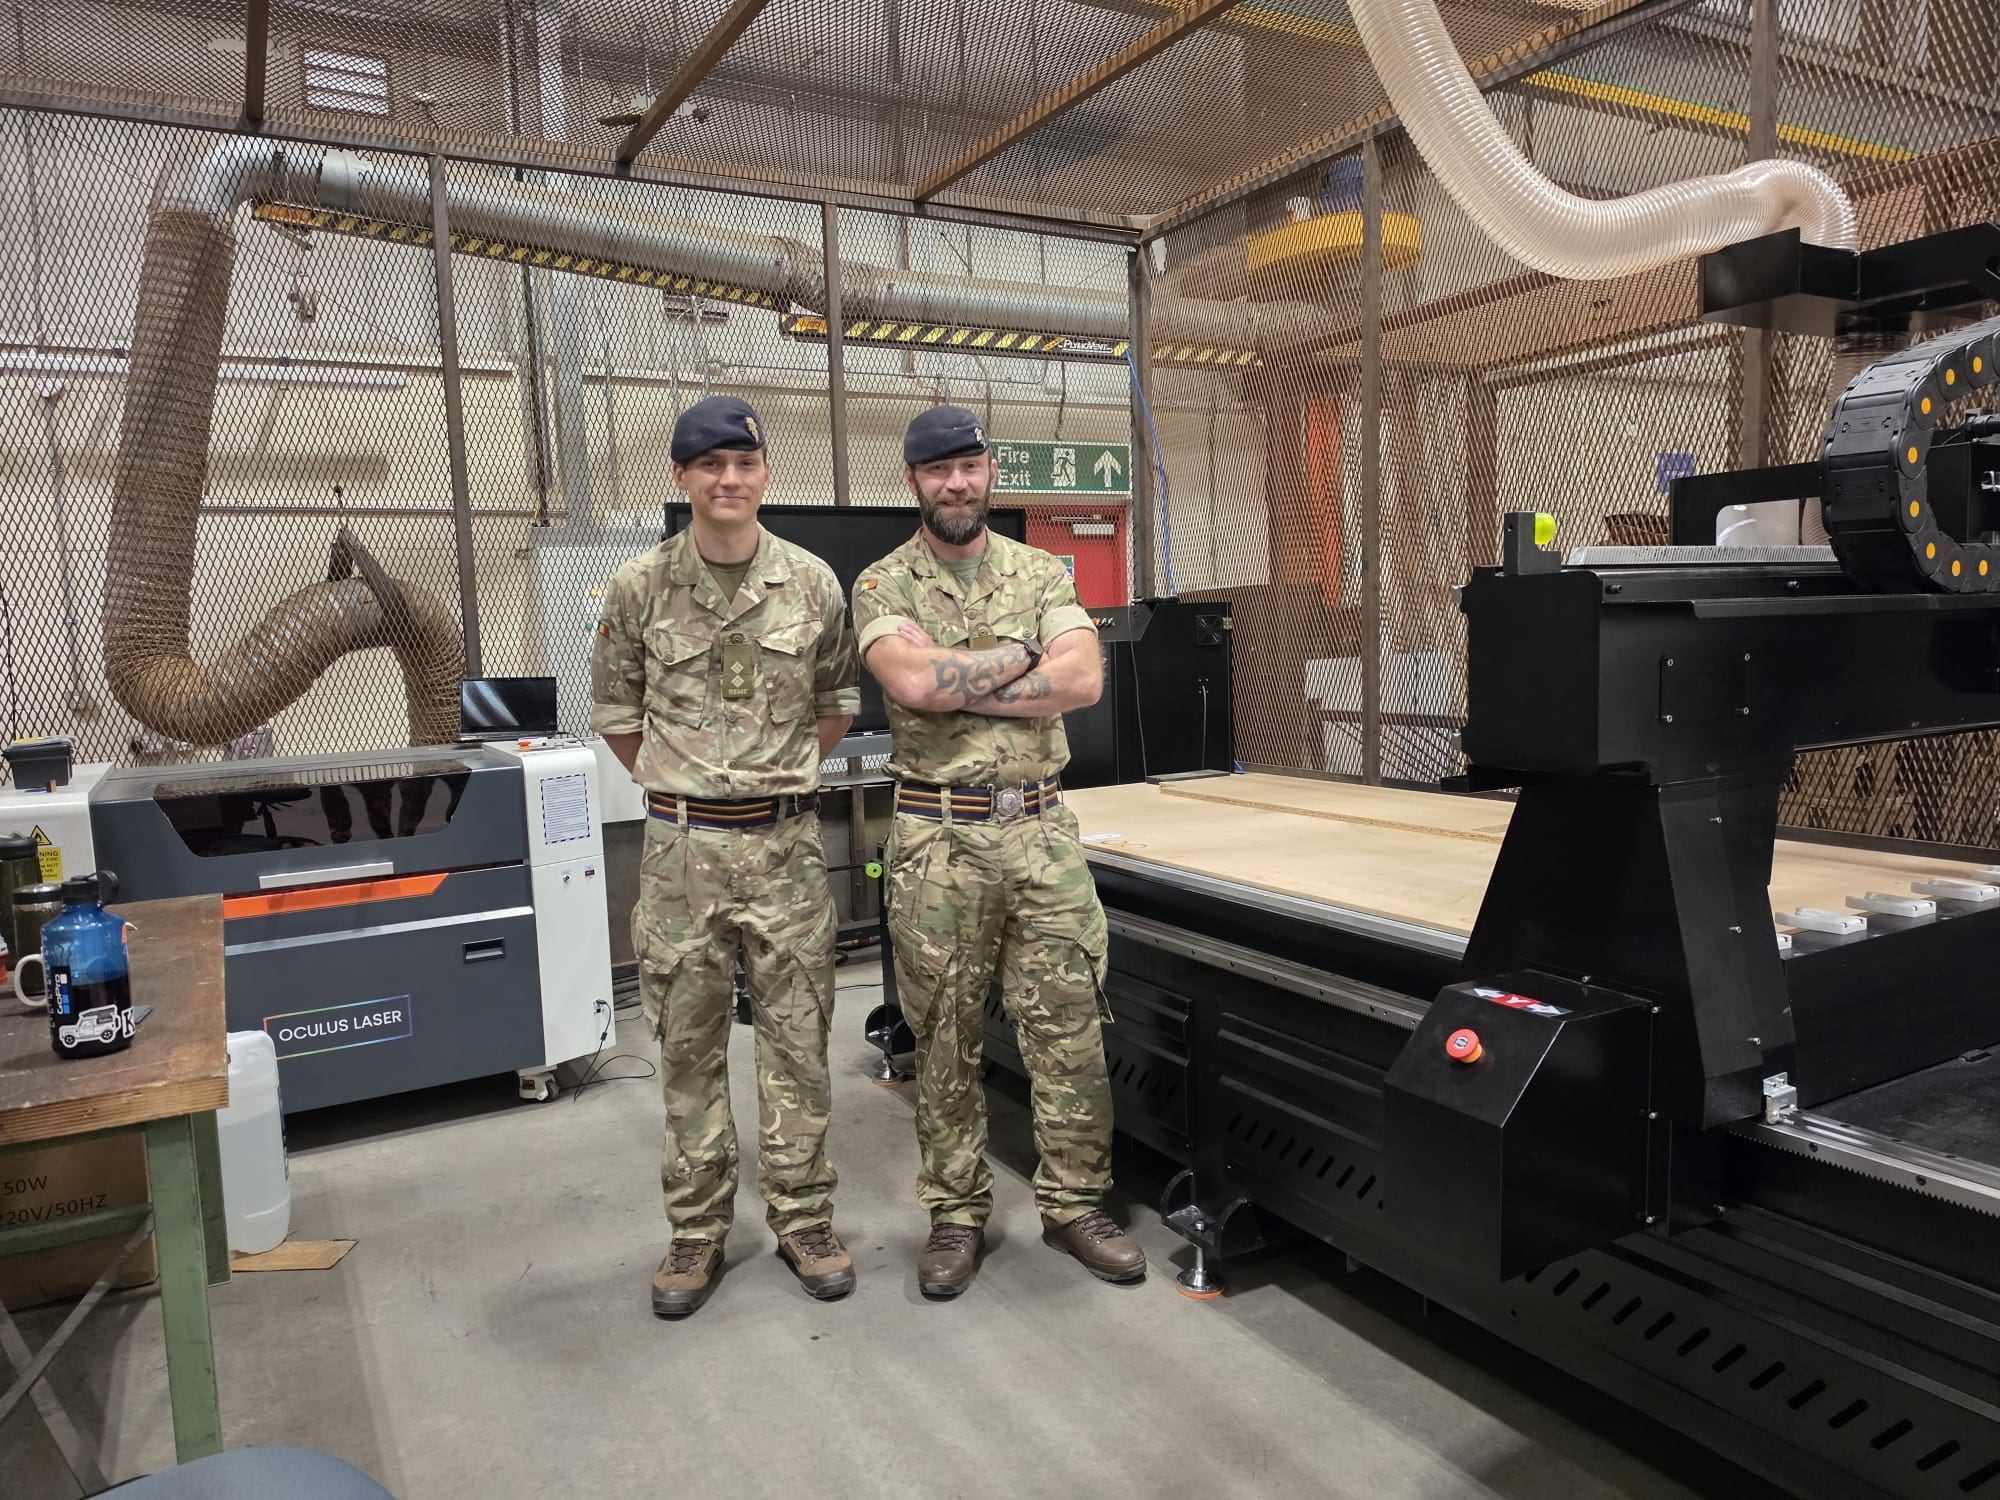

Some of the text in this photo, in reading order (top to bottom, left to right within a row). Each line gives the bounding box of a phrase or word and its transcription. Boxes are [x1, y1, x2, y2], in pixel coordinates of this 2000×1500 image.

[997, 446, 1030, 464] Fire
[997, 469, 1031, 486] Exit
[55, 973, 64, 1015] GoPro
[1505, 996, 1533, 1004] Y
[279, 1010, 402, 1042] OCULUS LASER
